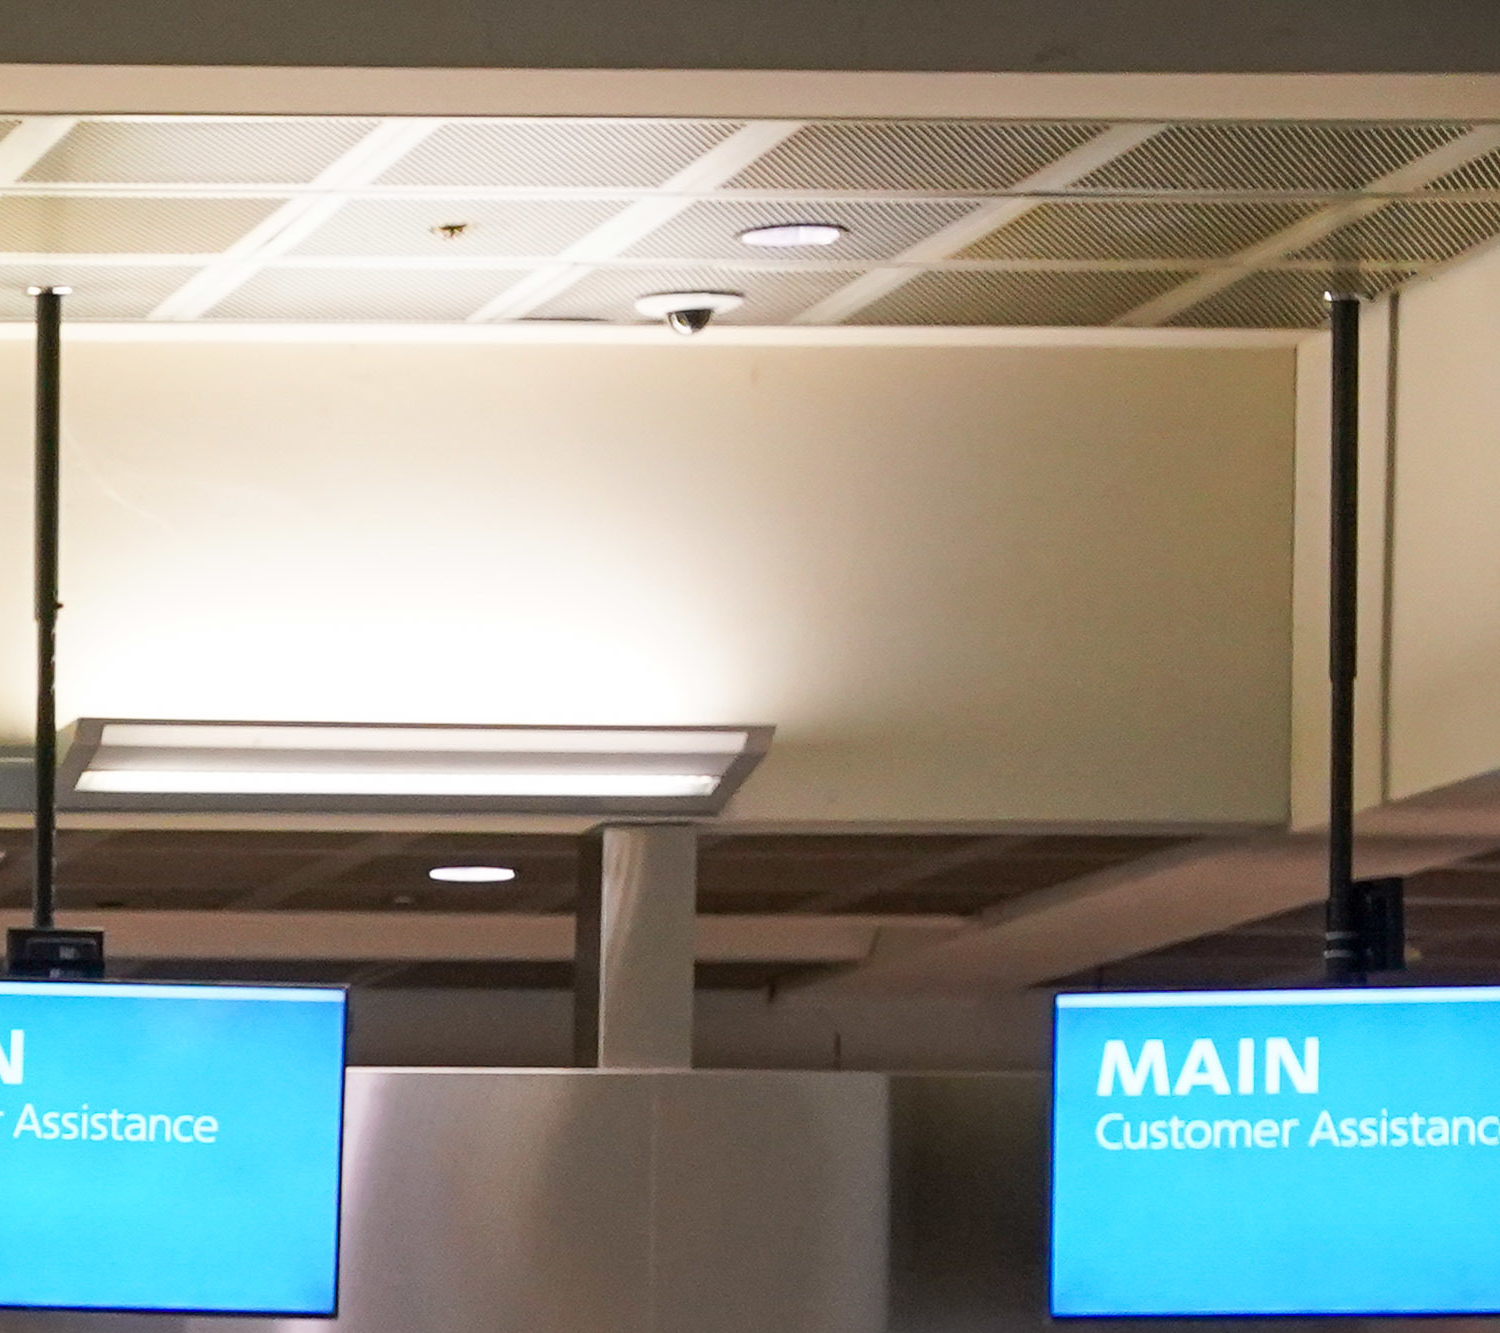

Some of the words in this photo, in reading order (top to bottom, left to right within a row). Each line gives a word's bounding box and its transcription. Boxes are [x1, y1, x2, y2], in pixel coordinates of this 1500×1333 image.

[1097, 1036, 1319, 1096] MAIN
[12, 1102, 219, 1143] Assistance
[1095, 1112, 1300, 1150] Customer
[1308, 1107, 1500, 1149] Assistanc
